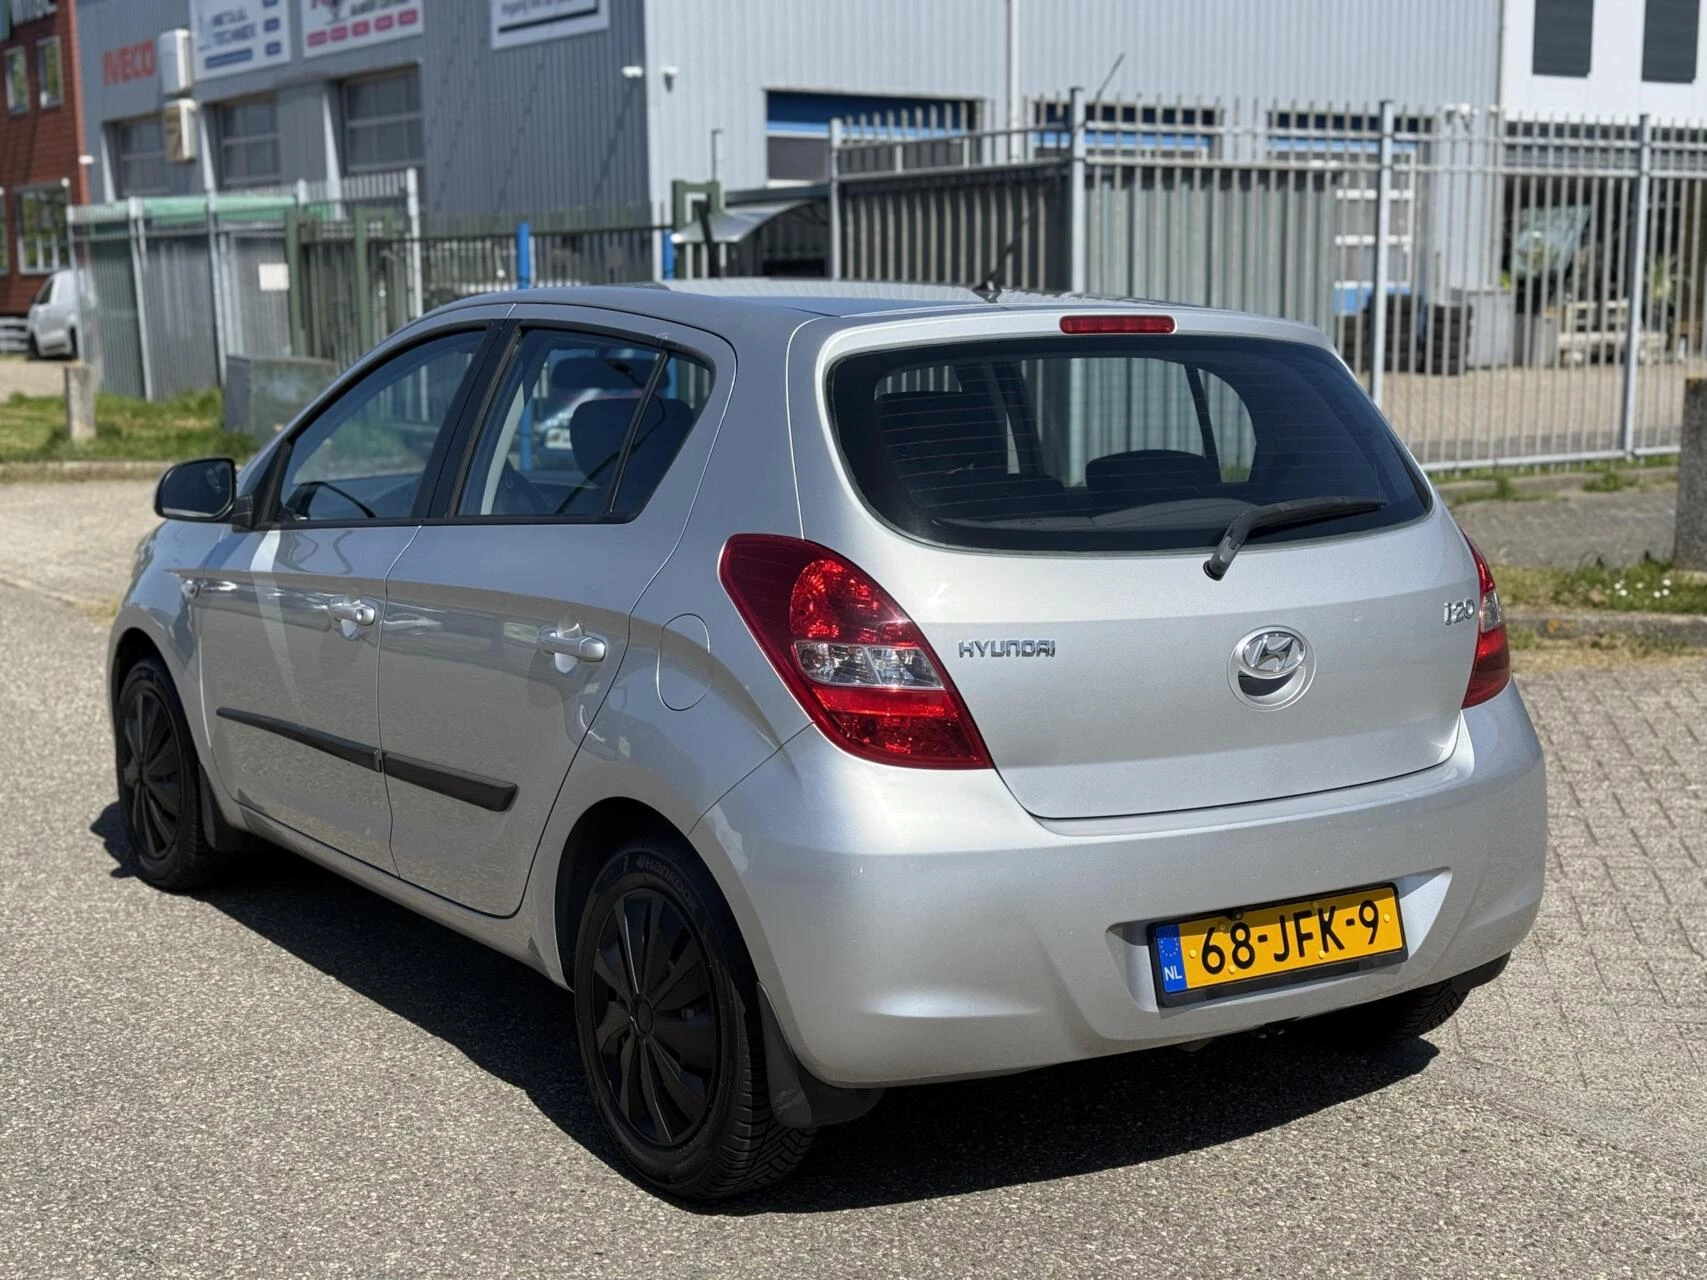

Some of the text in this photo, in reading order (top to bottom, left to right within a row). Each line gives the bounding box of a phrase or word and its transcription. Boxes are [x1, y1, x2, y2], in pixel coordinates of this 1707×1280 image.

[103, 39, 157, 87] IVECO
[1444, 599, 1475, 625] i20
[958, 639, 1056, 658] HYUNDAI
[1201, 900, 1379, 975] 68-JFK-9
[1164, 965, 1183, 981] NL
